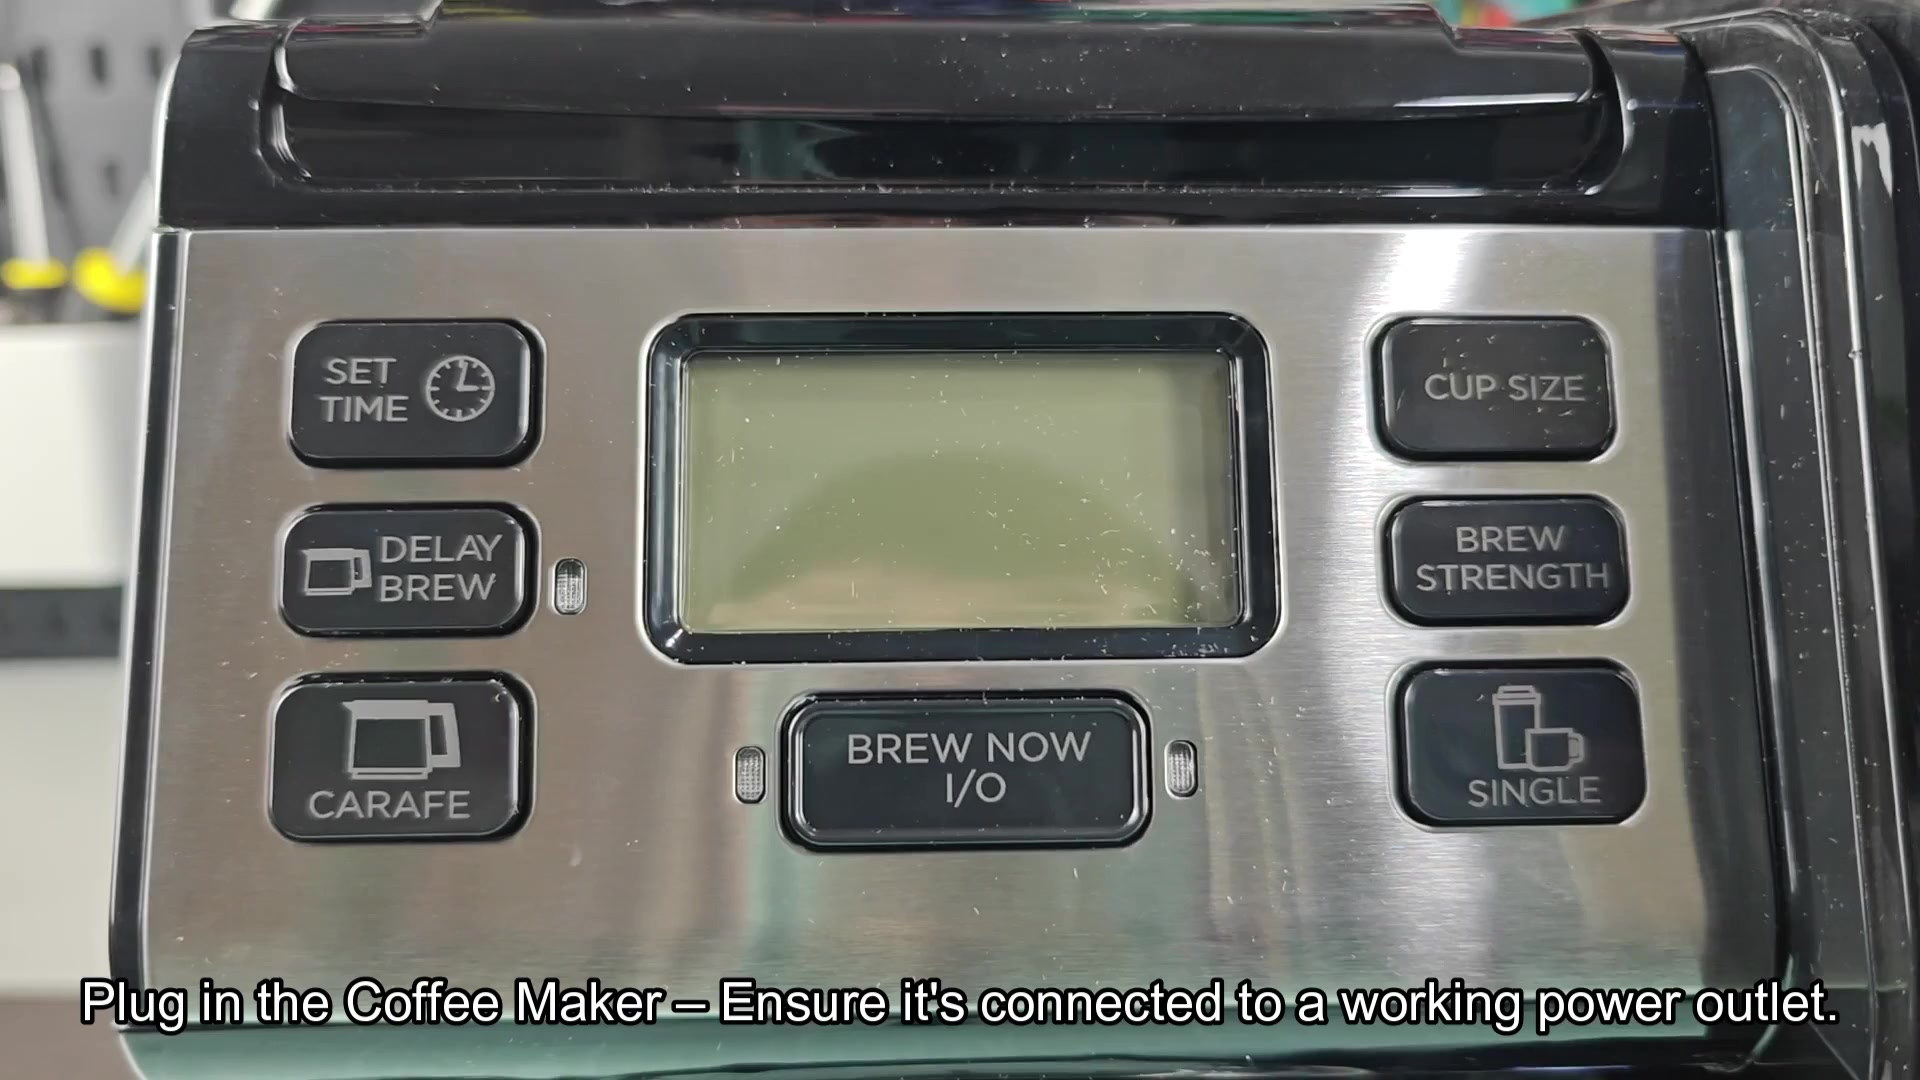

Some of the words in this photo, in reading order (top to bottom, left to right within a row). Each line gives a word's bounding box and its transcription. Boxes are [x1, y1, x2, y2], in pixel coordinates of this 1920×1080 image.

[323, 357, 397, 387] SET
[1424, 373, 1497, 403] CUP
[1508, 374, 1587, 403] SIZE
[319, 394, 409, 424] TIME
[379, 534, 503, 564] DELAY
[1455, 525, 1565, 554] BREW
[378, 572, 498, 604] BREW
[1415, 562, 1609, 593] STRENGTH
[847, 732, 974, 766] BREW
[986, 731, 1092, 764] NOW
[308, 789, 471, 820] CARAFE
[944, 771, 1008, 808] I/O
[1467, 776, 1602, 808] SINGLE
